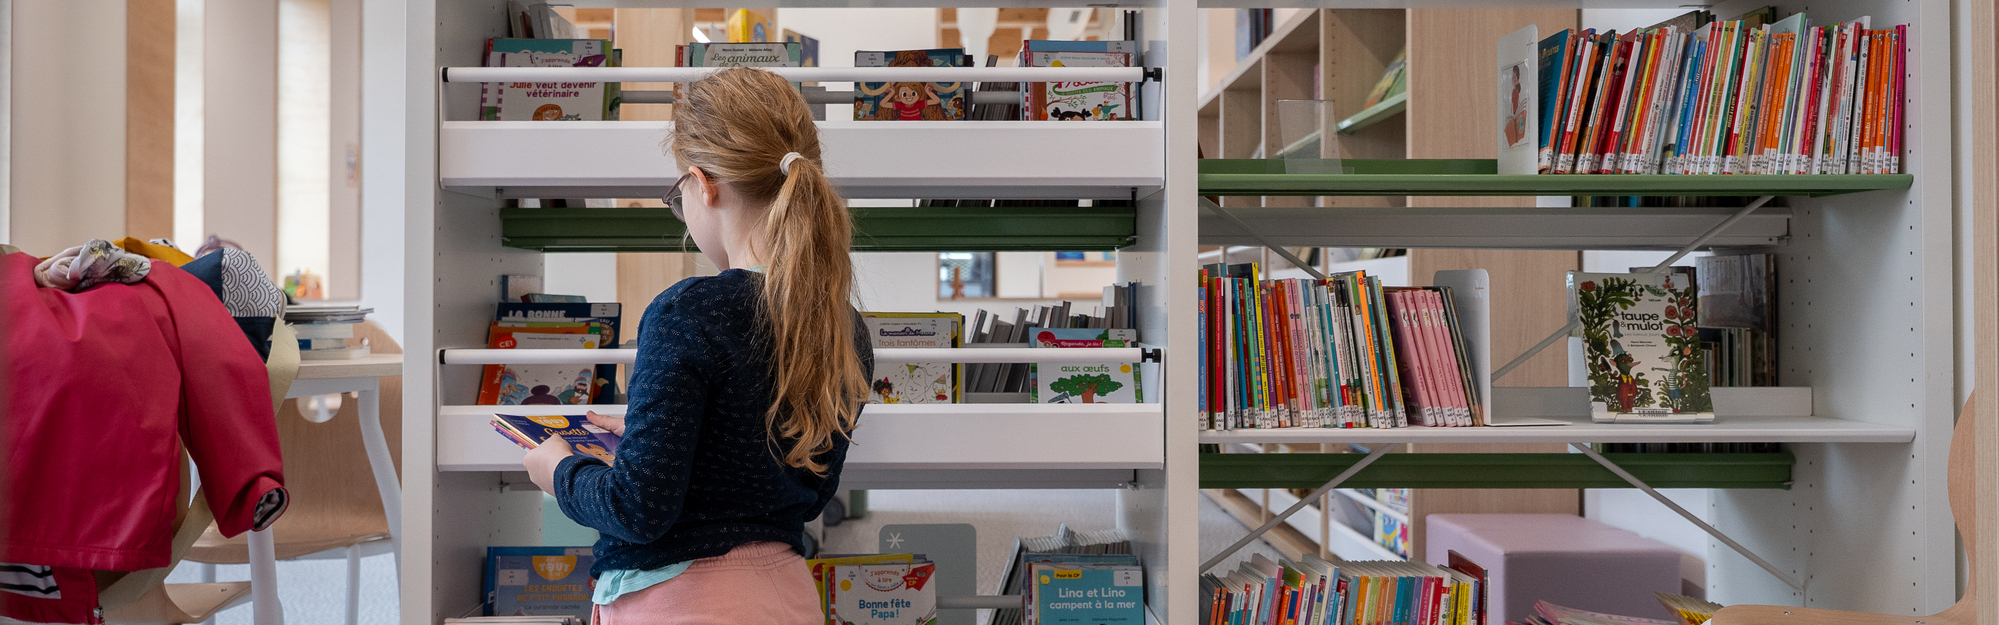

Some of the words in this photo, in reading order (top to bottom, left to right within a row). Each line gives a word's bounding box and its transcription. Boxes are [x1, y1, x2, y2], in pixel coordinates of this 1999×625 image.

[728, 53, 780, 62] animaux
[526, 90, 580, 98] vétérinaire
[1620, 312, 1660, 322] taupe
[1628, 320, 1664, 330] mulot
[896, 339, 936, 347] fantômes
[1083, 364, 1110, 372] œufs
[538, 563, 570, 572] TOUT
[542, 584, 582, 592] ENQUÊTES
[1058, 588, 1084, 598] Lina
[1086, 588, 1098, 598] et
[1101, 588, 1126, 598] Lino
[858, 600, 888, 609] Bonne
[891, 599, 911, 608] fête
[1050, 601, 1092, 610] campent
[1095, 600, 1102, 609] à
[1104, 600, 1114, 608] la
